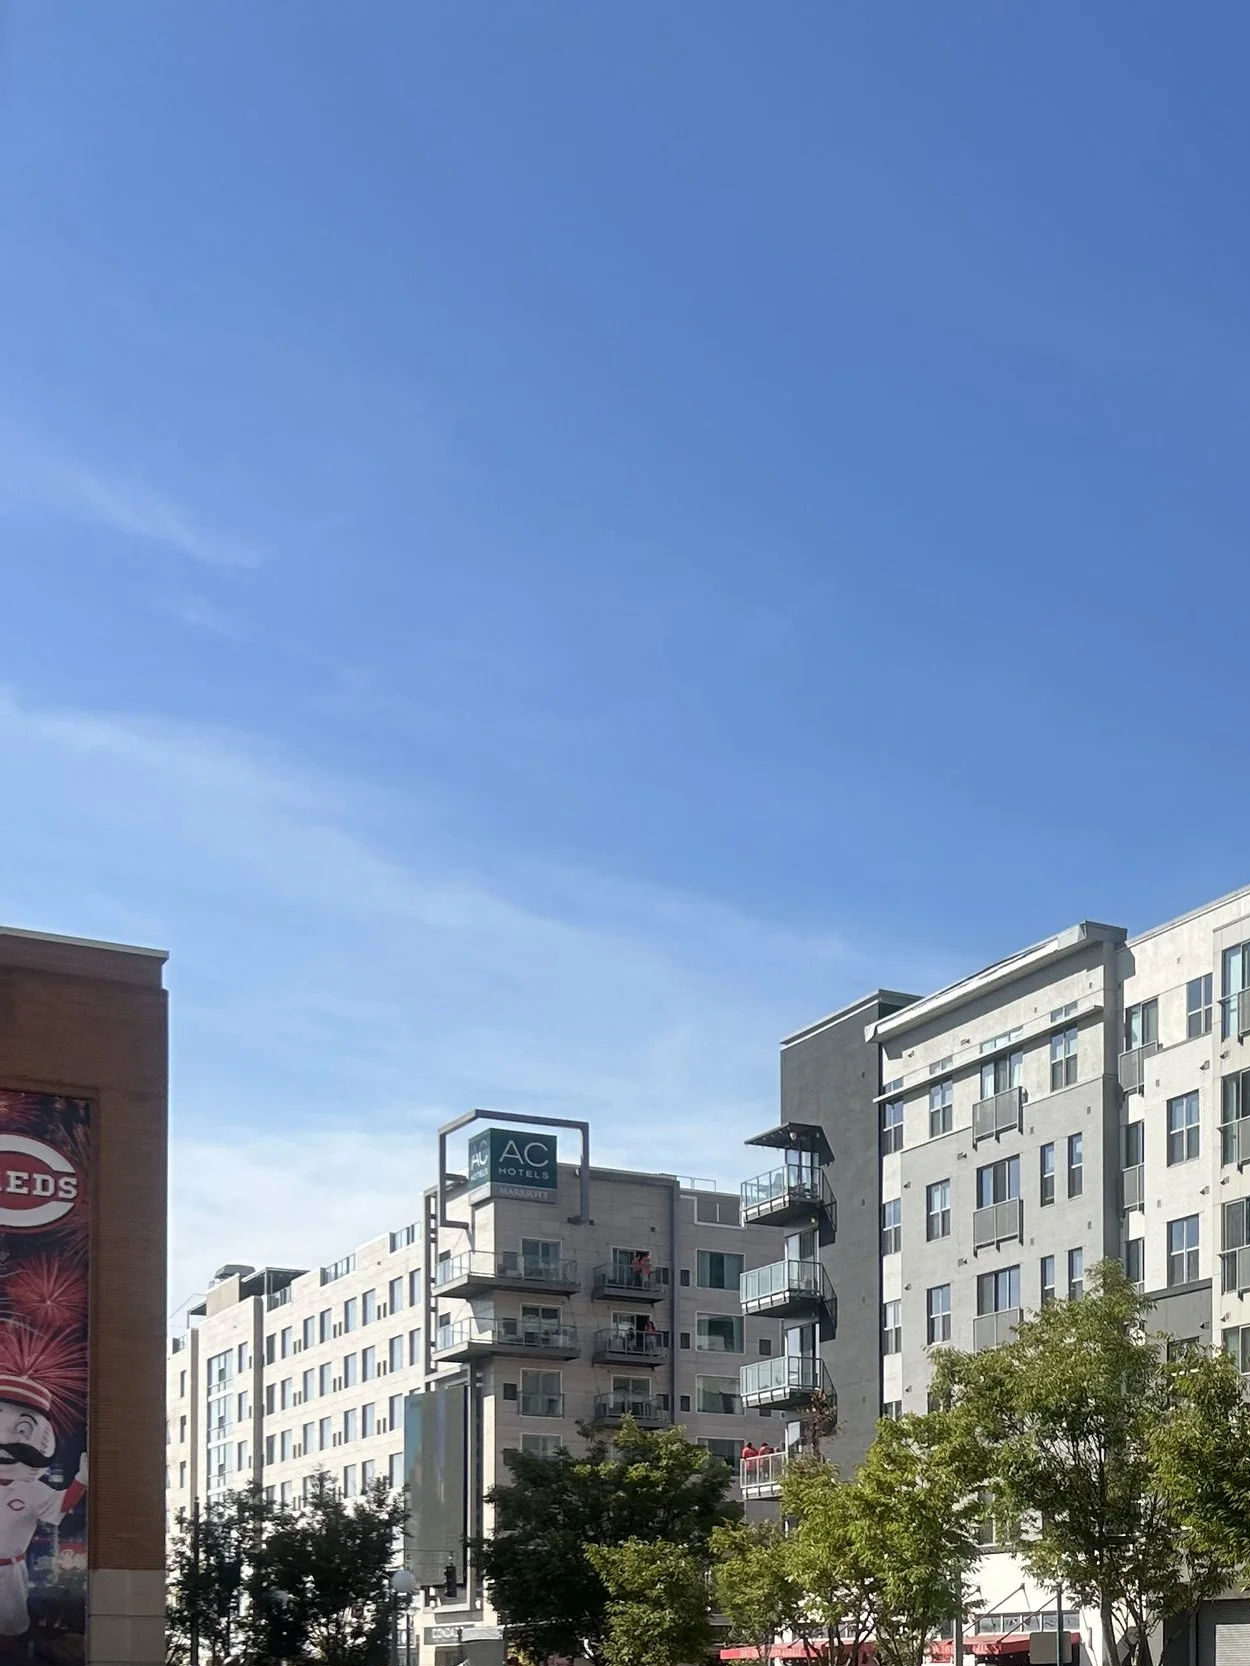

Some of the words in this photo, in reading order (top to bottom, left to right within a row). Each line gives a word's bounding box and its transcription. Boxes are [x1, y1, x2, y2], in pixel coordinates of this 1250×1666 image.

[498, 1139, 550, 1168] AC
[0, 1170, 78, 1199] EDS
[498, 1167, 550, 1181] HOTELS
[499, 1186, 549, 1200] MARRIOTT
